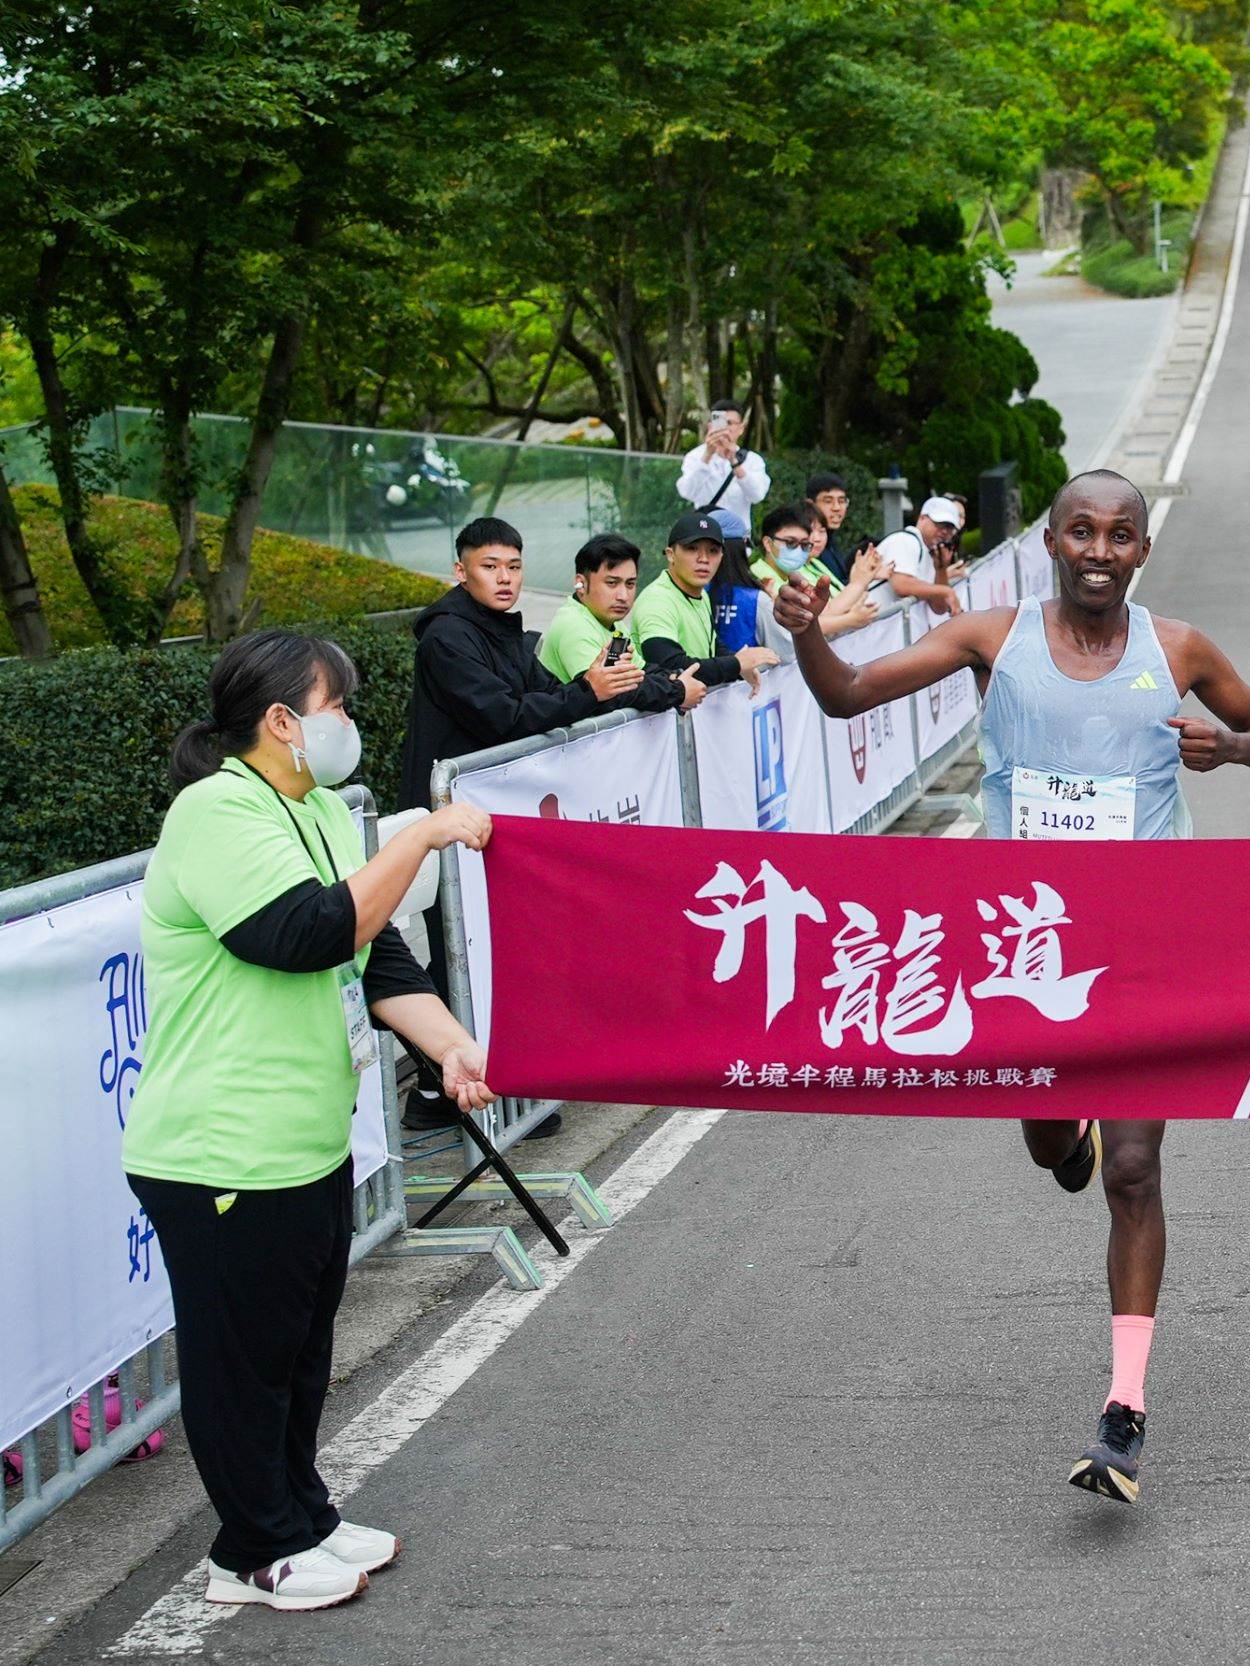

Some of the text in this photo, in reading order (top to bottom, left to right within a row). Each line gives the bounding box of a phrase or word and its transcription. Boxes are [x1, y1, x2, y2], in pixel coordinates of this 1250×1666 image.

[754, 706, 783, 802] LP
[1046, 775, 1098, 801] 升龍道
[1040, 811, 1096, 831] 11402
[682, 859, 1110, 1056] 升龍道
[721, 1059, 1058, 1089] 光境半程馬拉松挑戰賽
